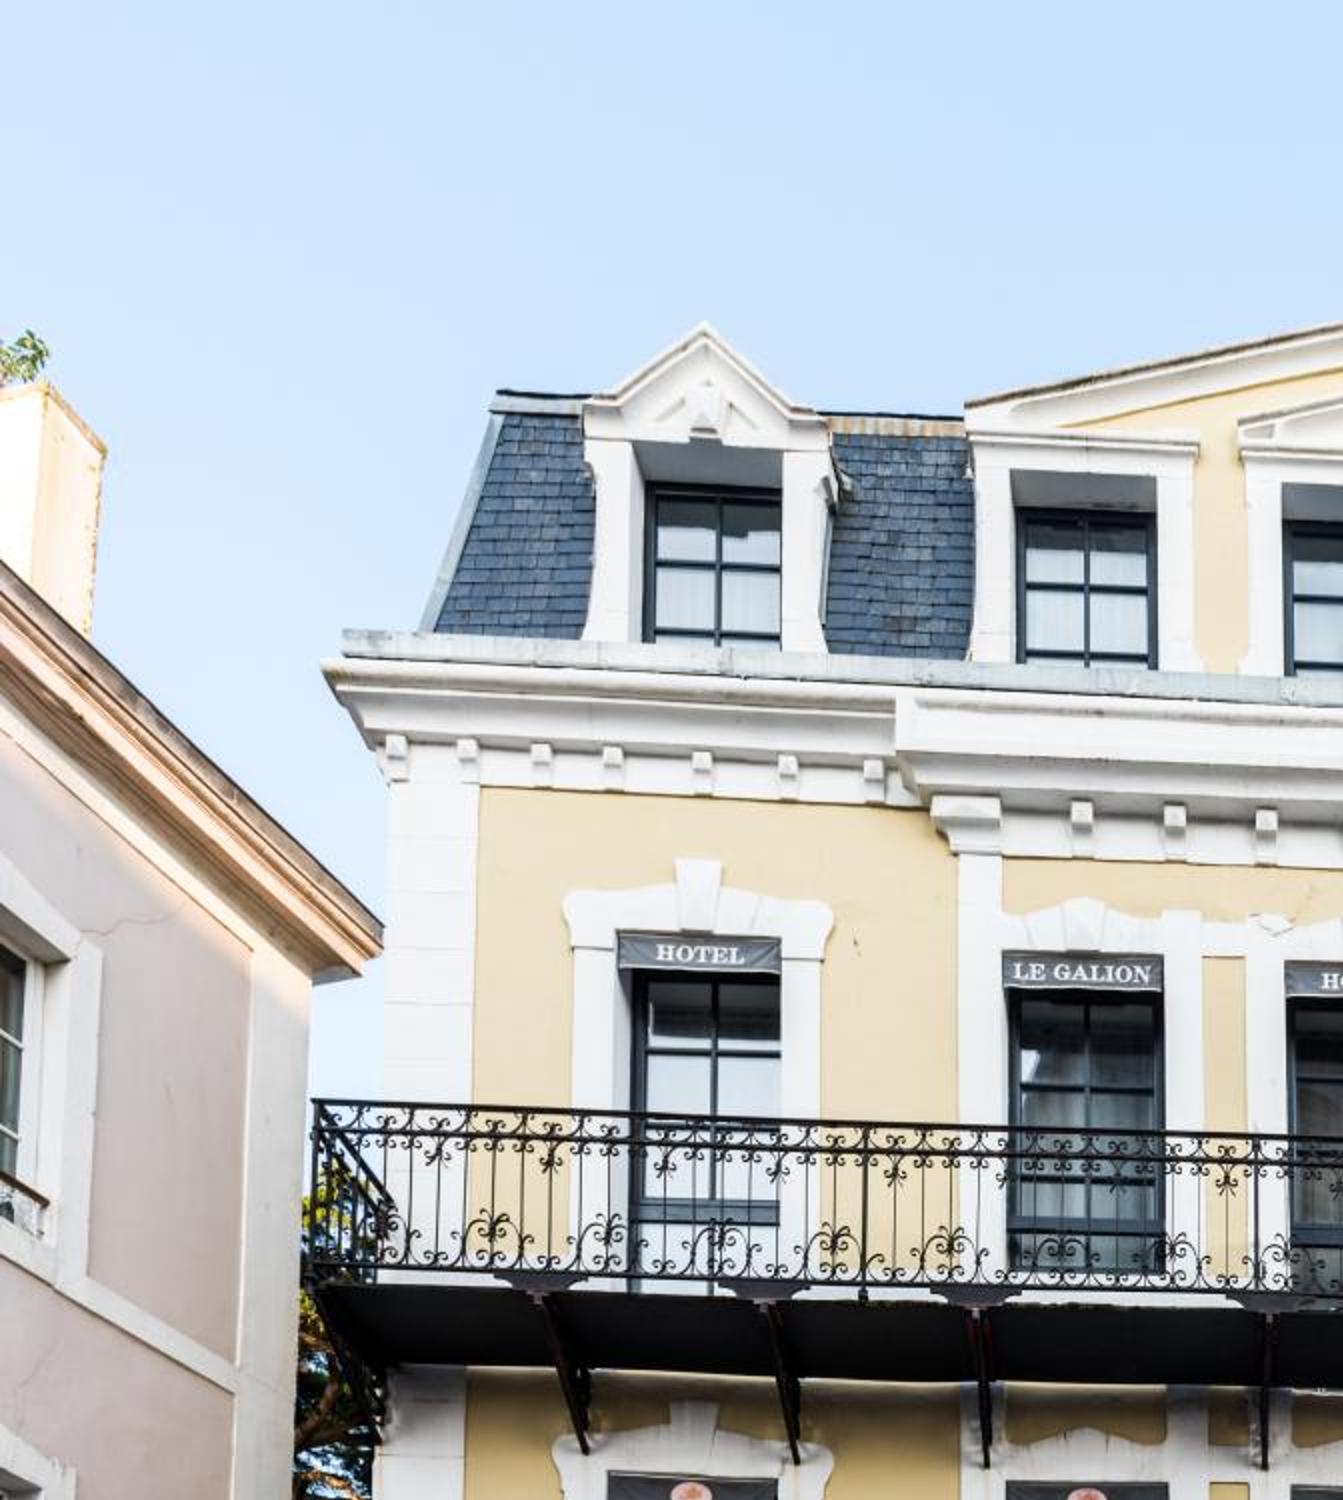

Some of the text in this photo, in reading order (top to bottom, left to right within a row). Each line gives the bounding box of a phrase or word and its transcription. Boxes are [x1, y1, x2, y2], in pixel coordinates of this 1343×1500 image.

[655, 943, 746, 966] HOTEL
[1012, 962, 1151, 985] LE GALION
